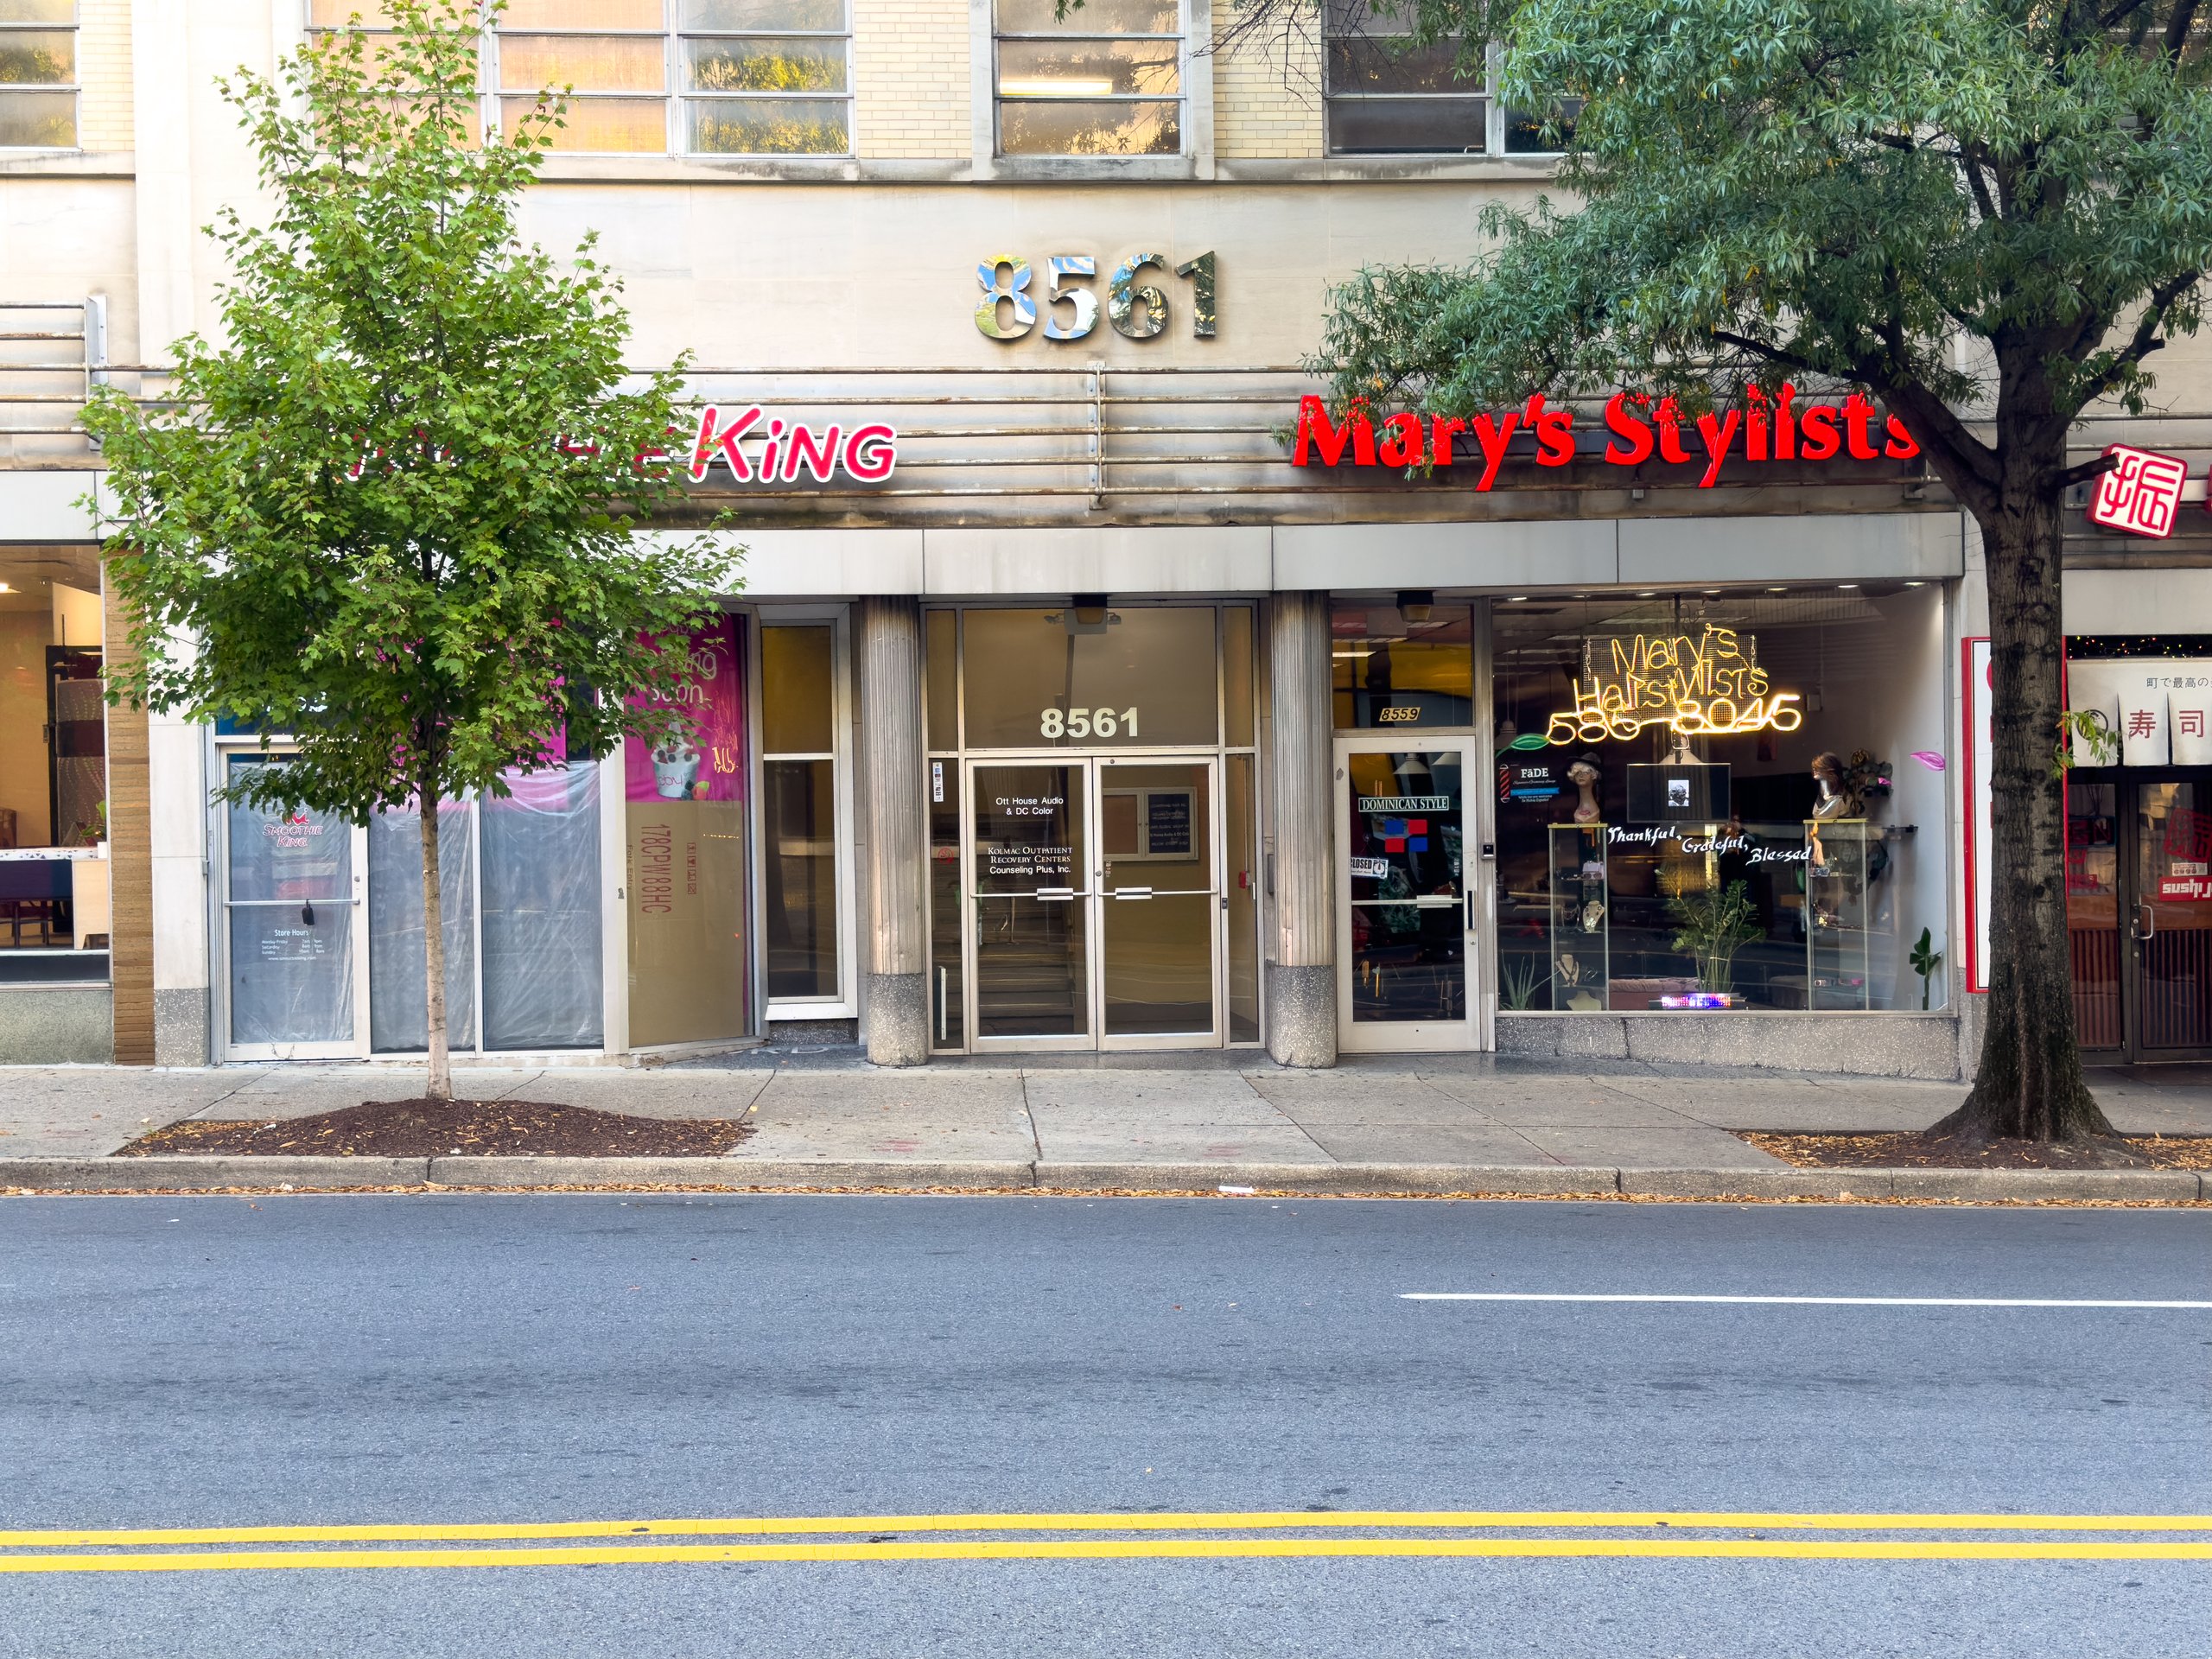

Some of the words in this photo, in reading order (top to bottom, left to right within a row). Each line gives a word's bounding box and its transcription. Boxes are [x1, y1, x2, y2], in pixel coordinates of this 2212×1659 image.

[975, 251, 1217, 340] 8561
[1292, 391, 1574, 492] Mary's
[1605, 382, 1921, 488] Stylists
[1611, 622, 1739, 675] Mary's
[2146, 677, 2212, 689] 町で最高の
[1040, 707, 1138, 739] 8561
[1382, 709, 1418, 720] 8559
[2128, 709, 2204, 739] 寿司
[1363, 798, 1417, 810] DOMINICAN
[1420, 798, 1447, 809] STYLE
[263, 823, 324, 836] SMOOTHIE
[1607, 826, 1682, 847] Thankful,
[1681, 835, 1749, 856] Grateful,
[1745, 846, 1813, 866] Blessed
[1034, 855, 1071, 863] CENTERS
[989, 866, 1033, 874] Counseling
[2163, 879, 2202, 898] sushi
